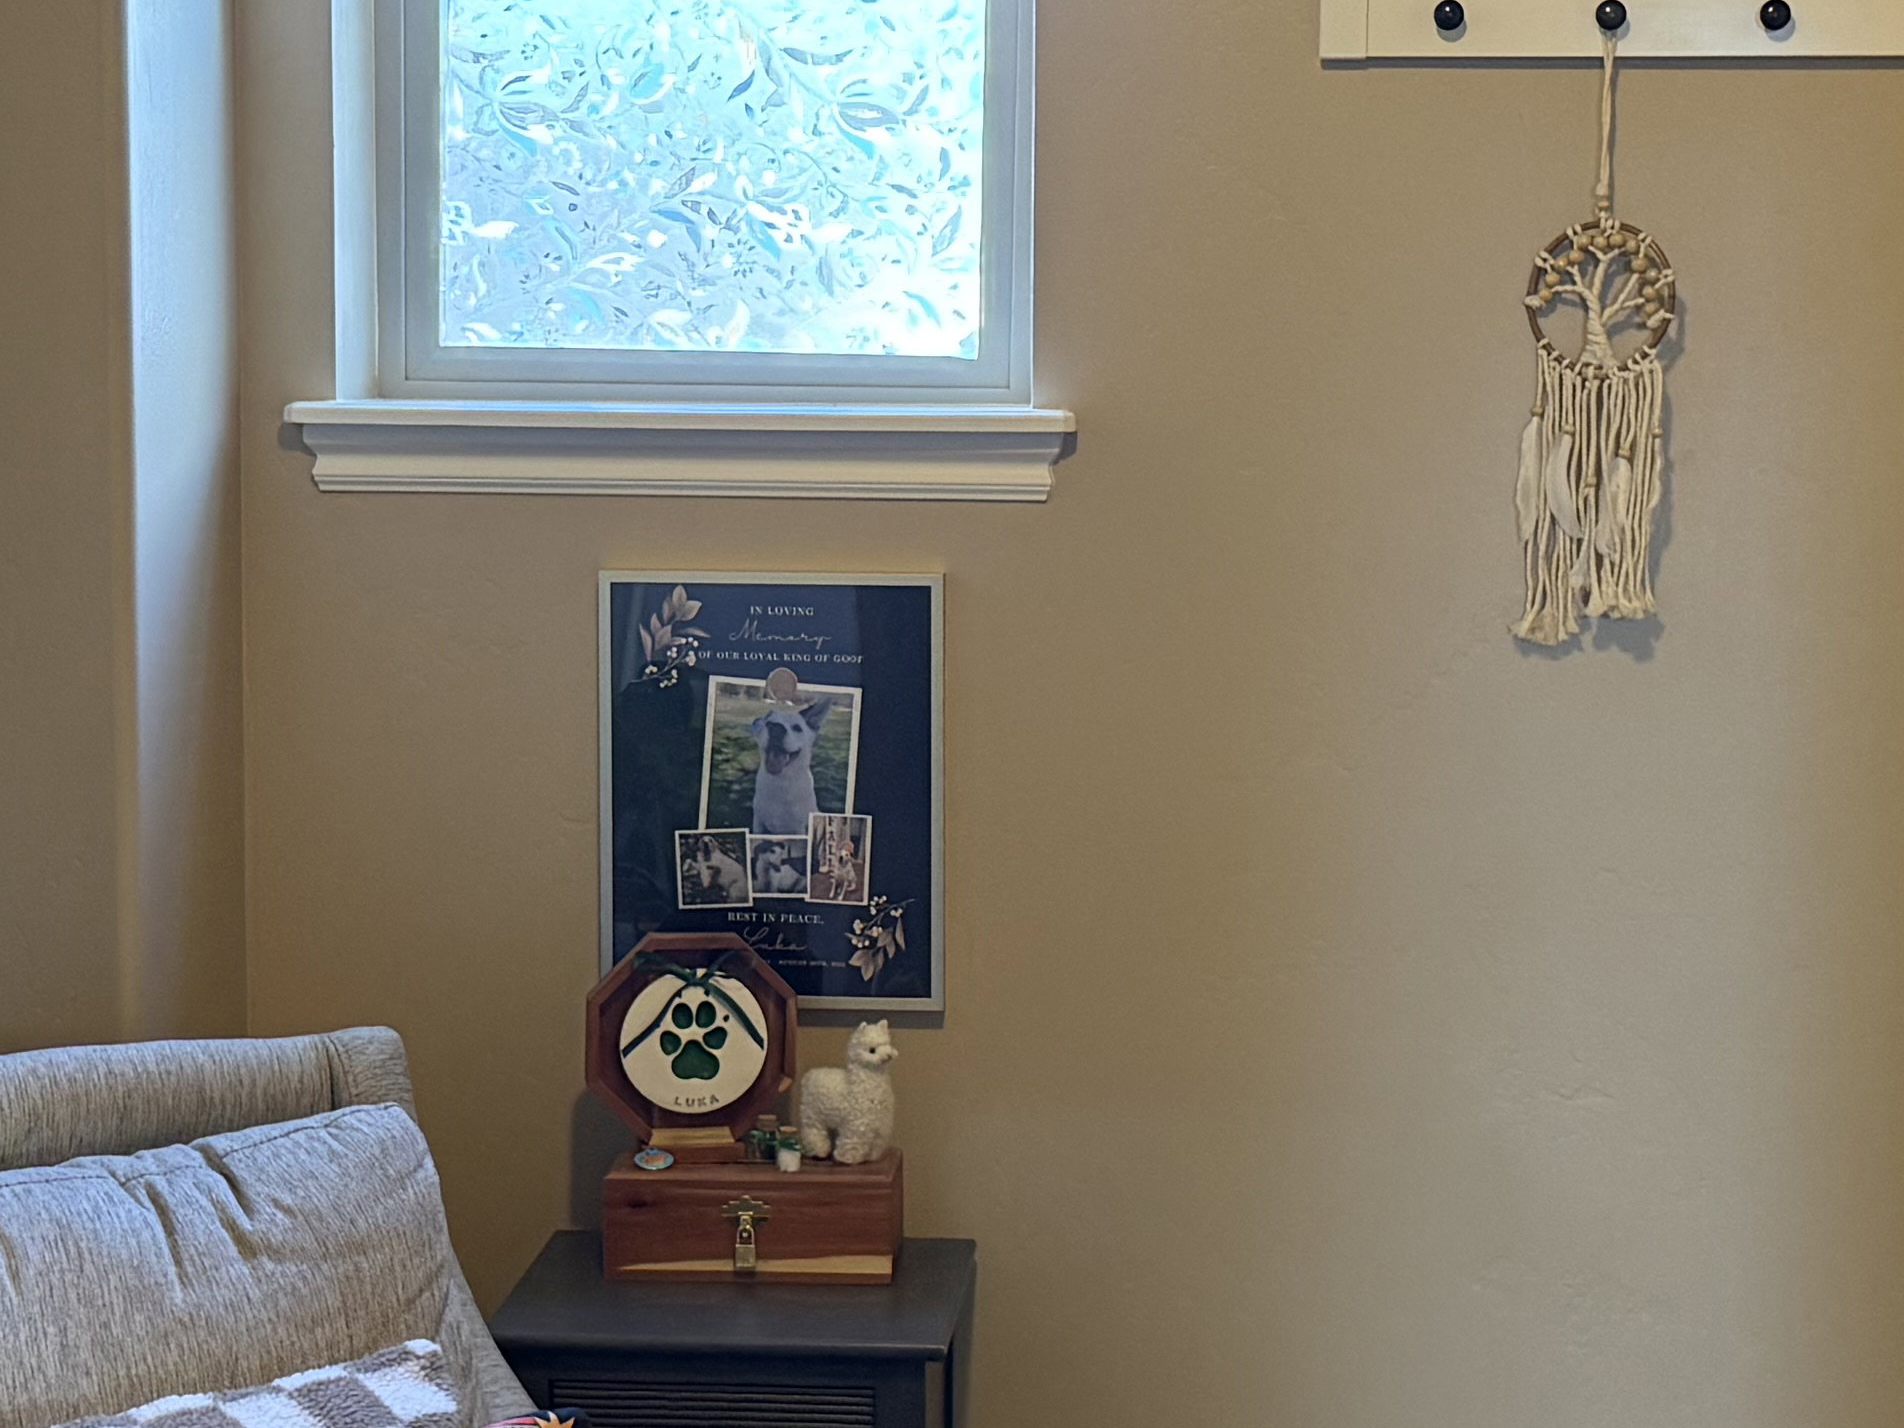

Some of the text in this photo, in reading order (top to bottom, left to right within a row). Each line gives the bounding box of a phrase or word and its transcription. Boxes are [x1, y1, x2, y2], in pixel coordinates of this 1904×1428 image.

[749, 605, 815, 617] IN LOVING
[729, 617, 832, 651] Memory
[743, 651, 780, 662] LOYAL
[727, 911, 759, 923] REST
[762, 912, 776, 923] IN
[674, 1093, 720, 1108] LUKA
